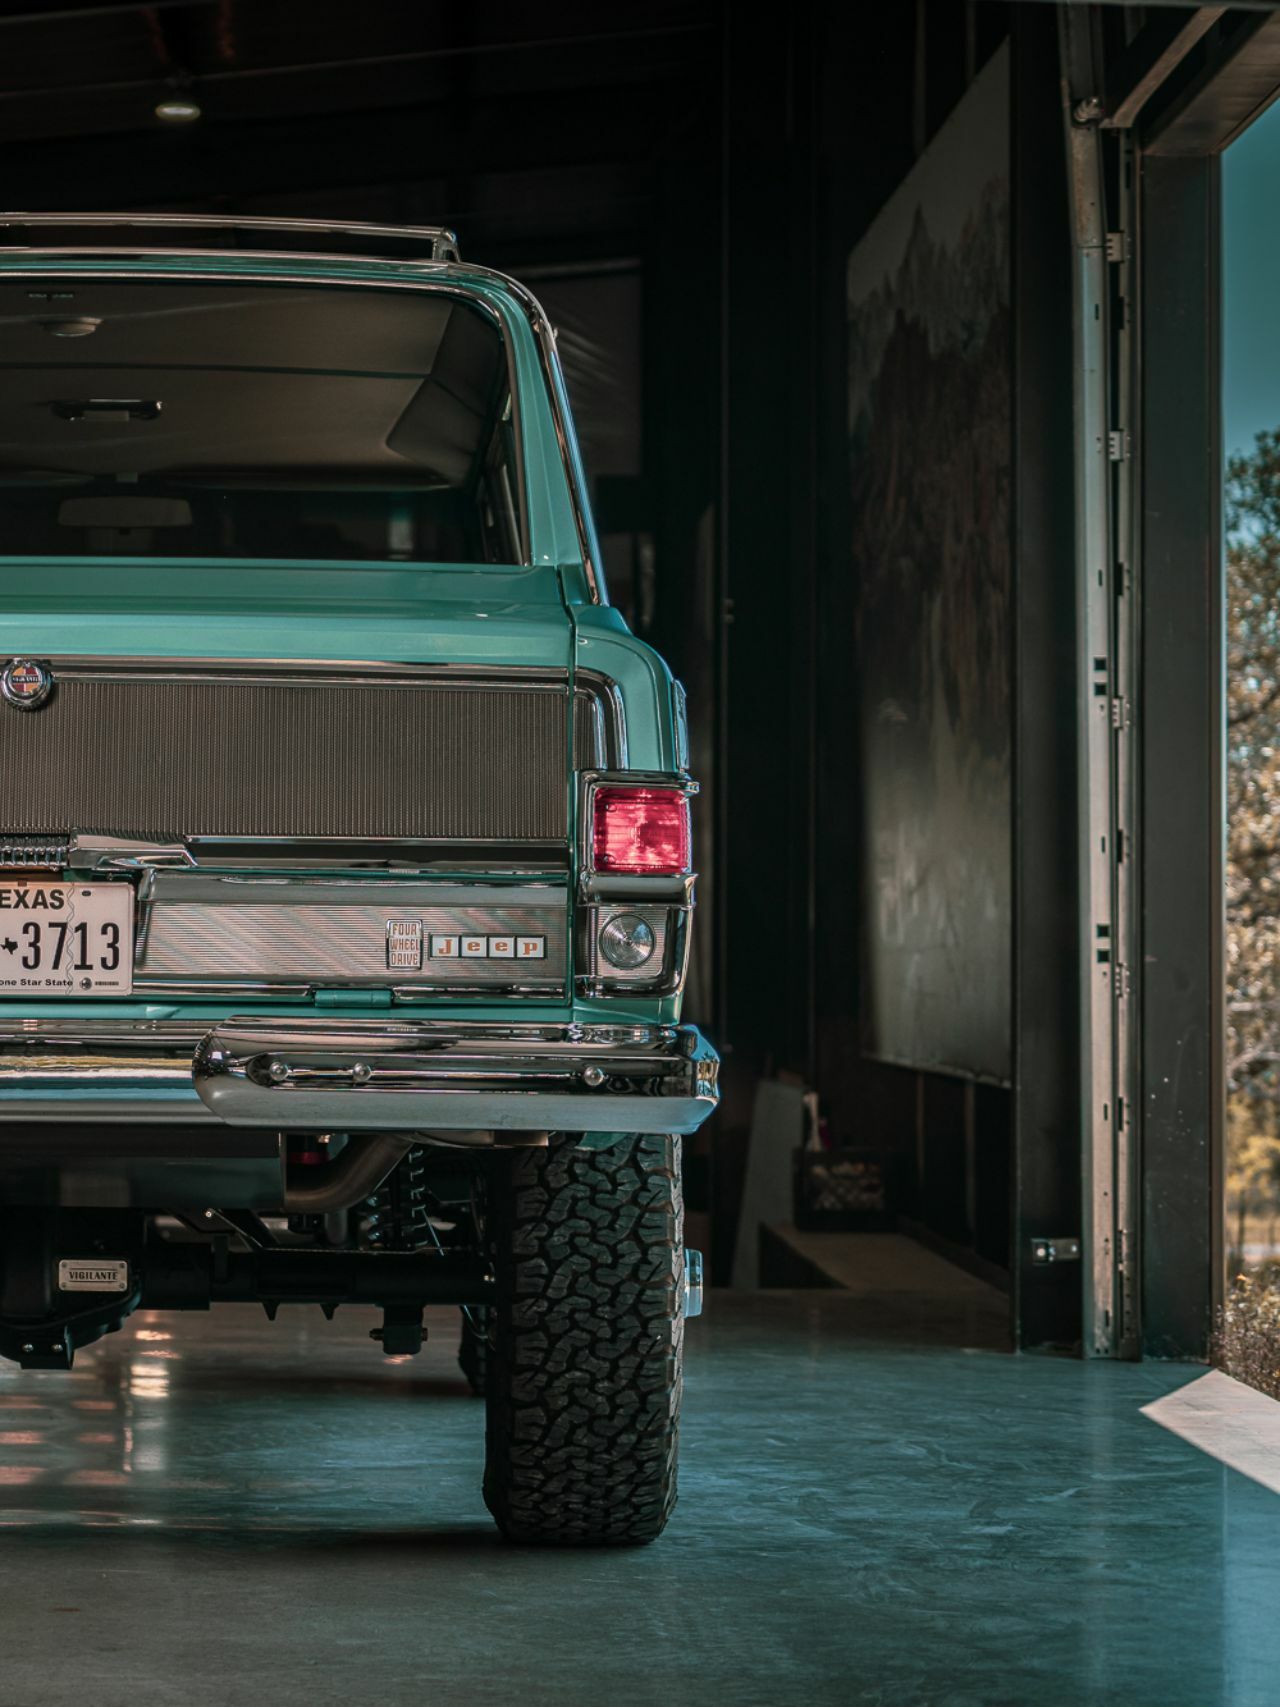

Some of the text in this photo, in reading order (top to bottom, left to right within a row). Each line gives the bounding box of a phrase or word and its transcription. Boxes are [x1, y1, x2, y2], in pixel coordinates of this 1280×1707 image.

[392, 923, 417, 935] FOUR
[22, 921, 120, 970] 3713
[389, 938, 419, 951] WHEEL
[438, 939, 538, 956] Jeep
[391, 954, 418, 966] DRIVE
[20, 978, 42, 986] Star
[45, 978, 74, 986] State
[69, 1271, 118, 1280] VIGILANTE
